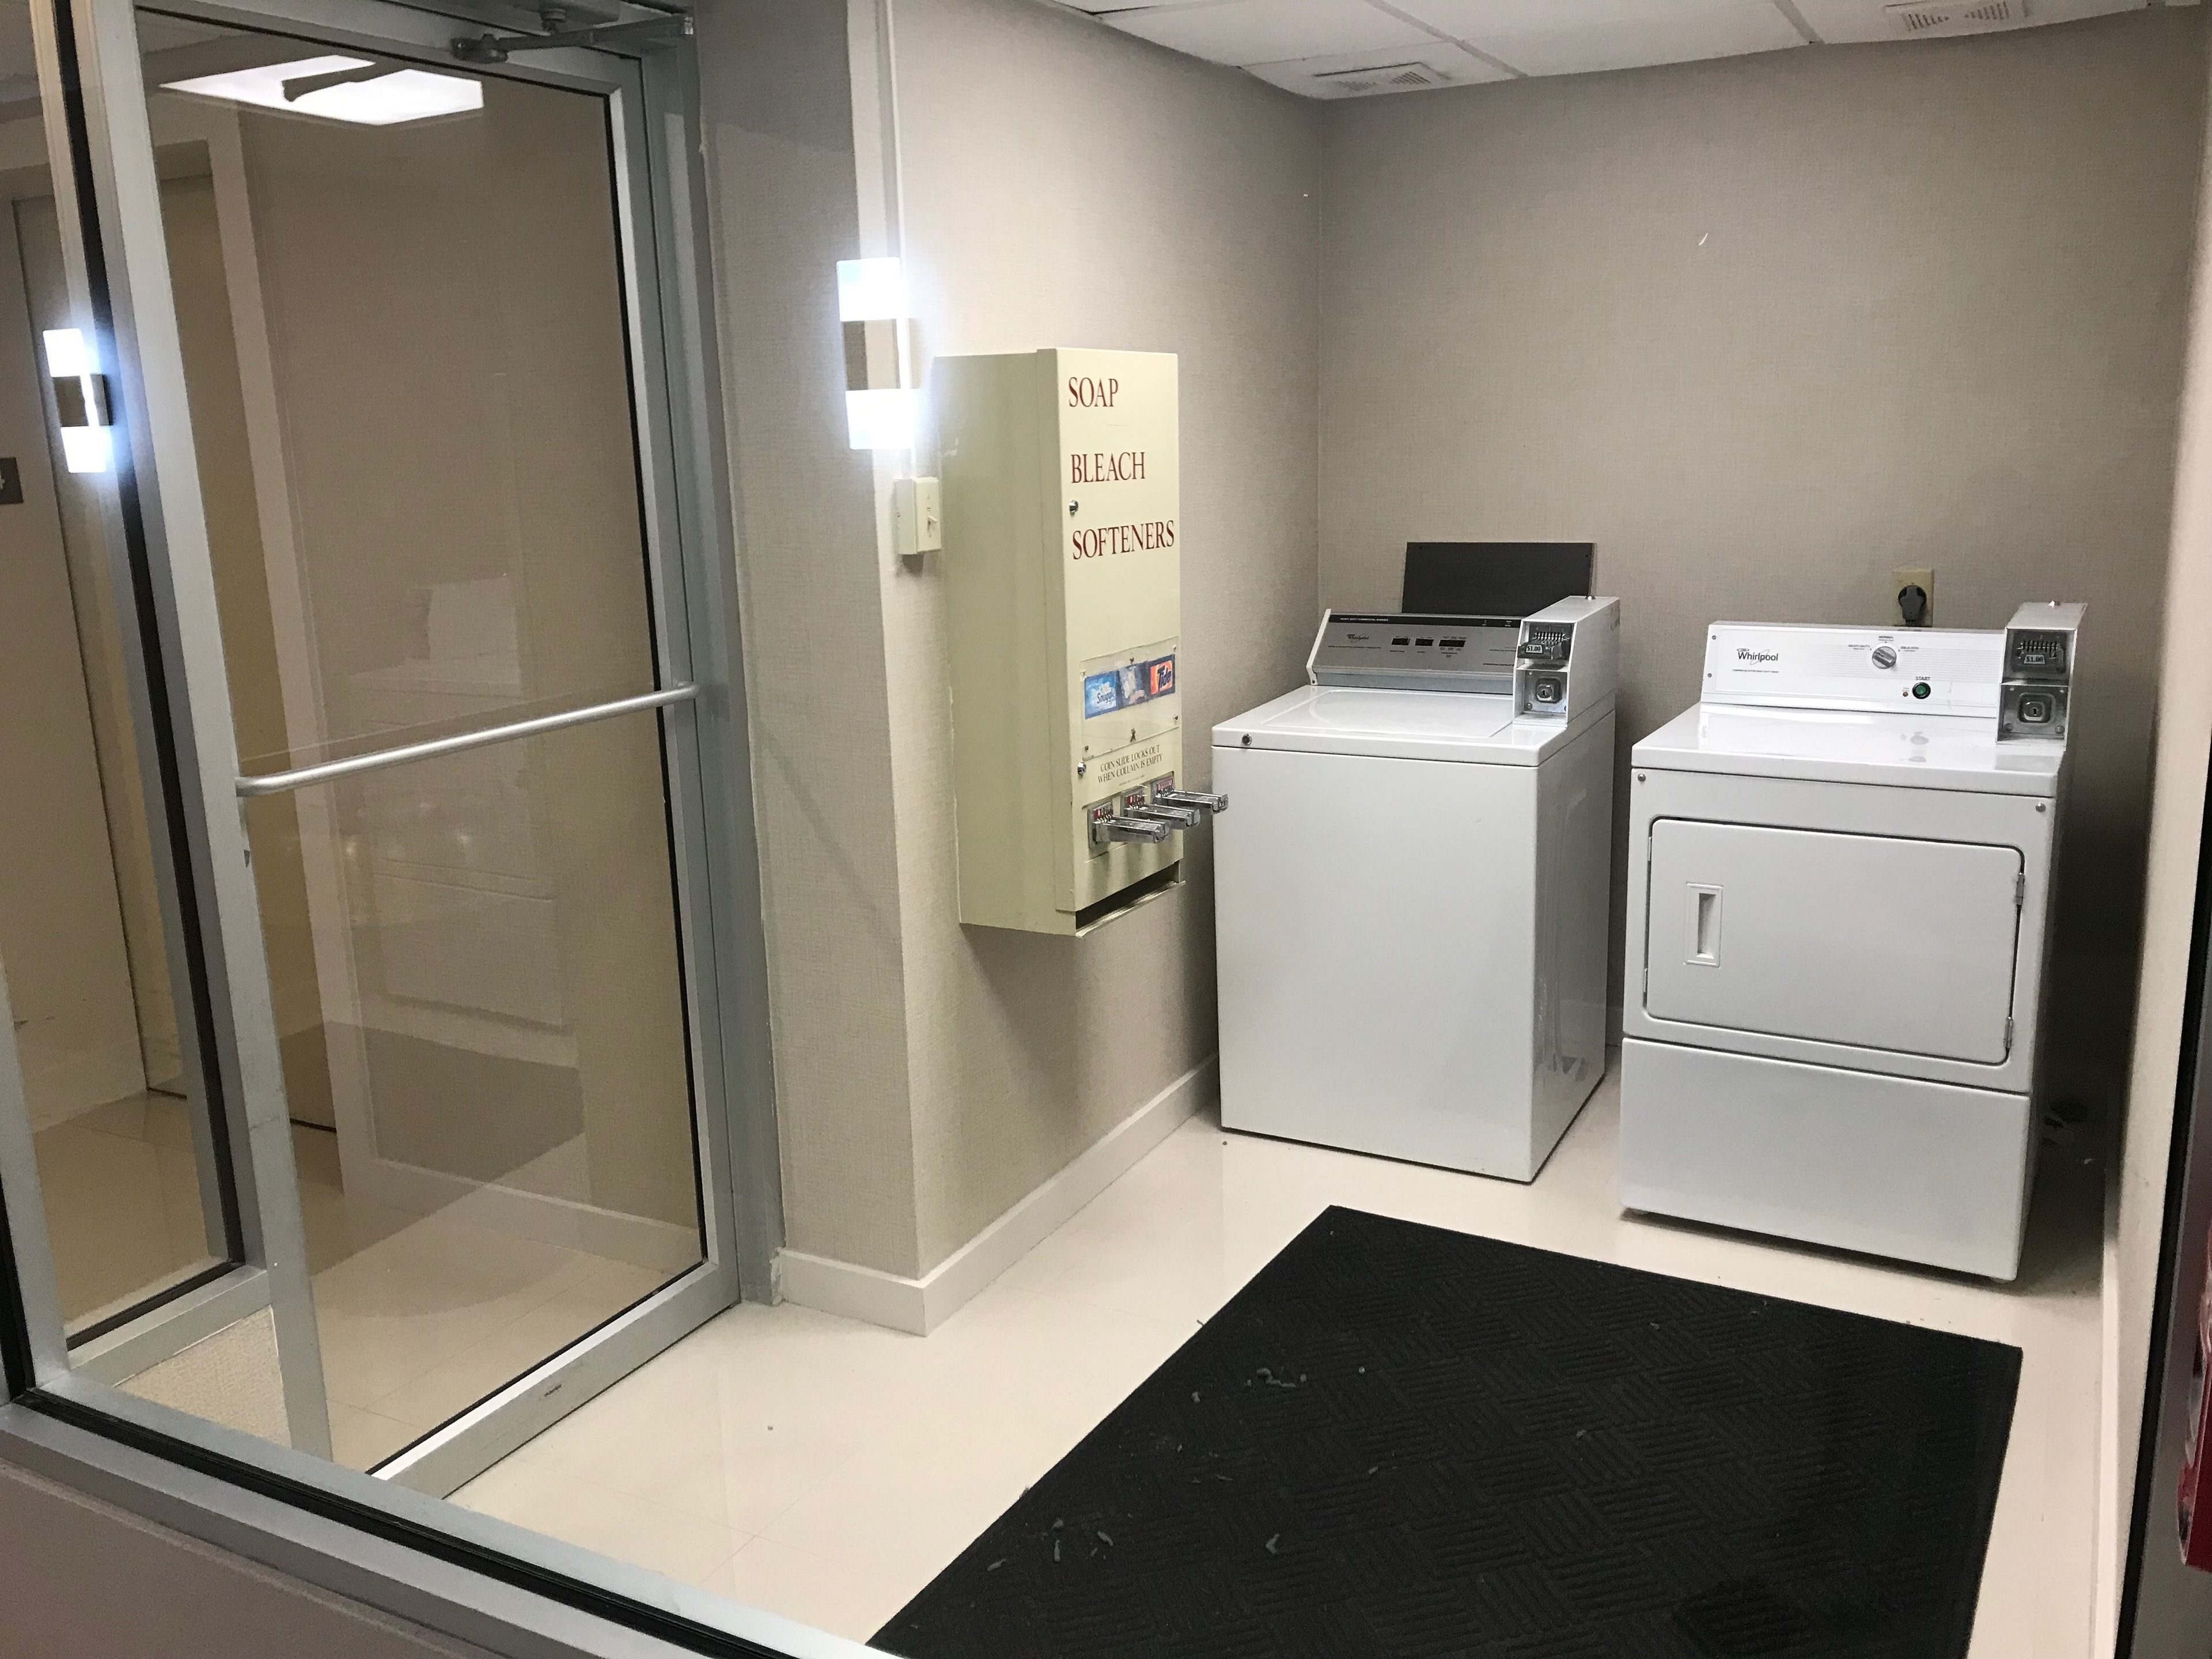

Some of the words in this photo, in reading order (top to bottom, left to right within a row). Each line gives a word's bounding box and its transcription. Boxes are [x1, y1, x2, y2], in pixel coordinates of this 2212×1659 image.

[1069, 377, 1118, 407] SOAP
[1071, 452, 1146, 483] BLEACH
[1073, 520, 1175, 560] SOFTENERS
[1738, 652, 1778, 662] Whirlpool
[1157, 664, 1172, 692] Tide
[1098, 772, 1115, 783] WHEN
[1116, 763, 1139, 777] COLUMN
[1141, 760, 1146, 768] IS
[1146, 754, 1162, 766] EMPTY
[1100, 761, 1115, 772] COIN
[1116, 755, 1130, 766] SLIDE
[1131, 750, 1148, 762] LOCKS
[1149, 744, 1160, 755] OUT
